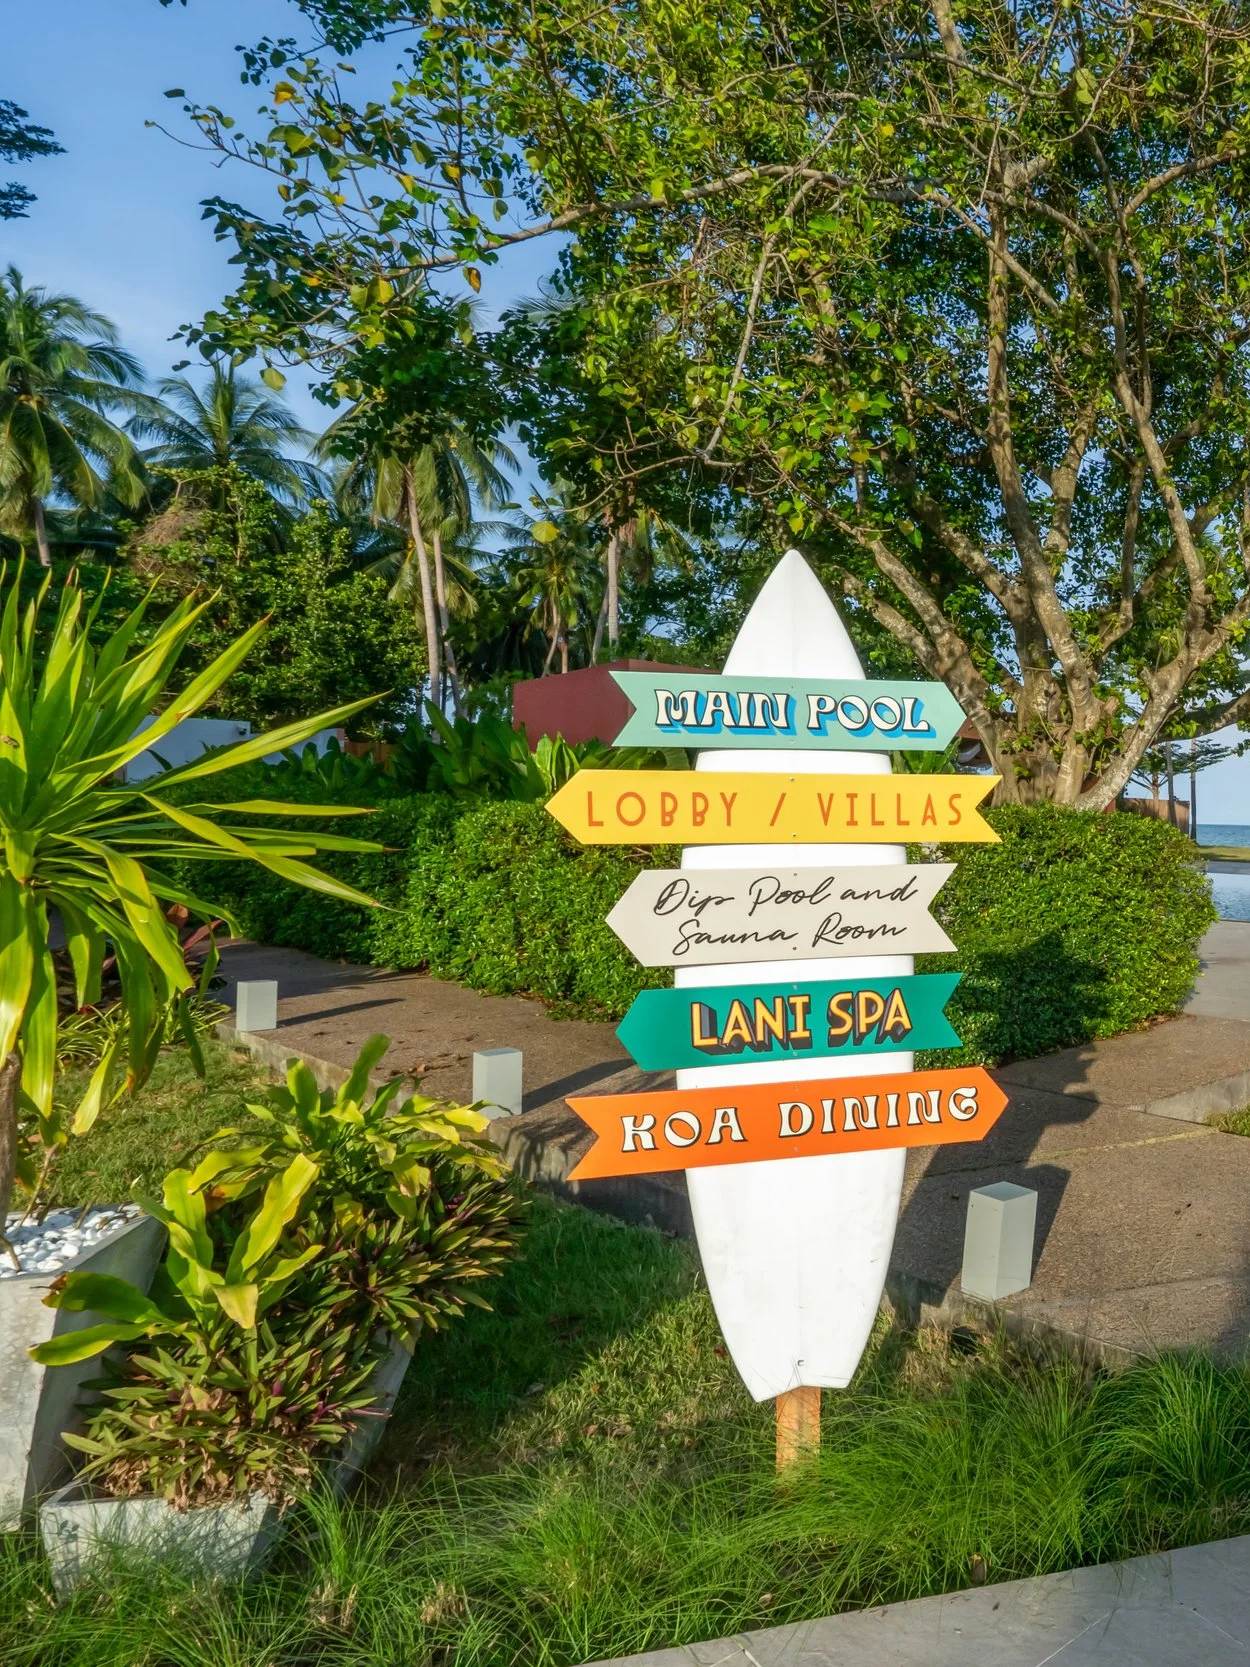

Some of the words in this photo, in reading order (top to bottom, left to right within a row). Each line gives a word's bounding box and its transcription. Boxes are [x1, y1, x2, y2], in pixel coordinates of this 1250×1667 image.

[654, 688, 797, 736] MAIN
[807, 693, 937, 740] POOL
[587, 790, 738, 827] LOBBY
[769, 792, 787, 827] /
[816, 792, 962, 827] VILLAS
[653, 878, 735, 917] Dip
[749, 876, 835, 917] Pool
[840, 875, 919, 902] and
[672, 919, 799, 956] Sauna
[812, 912, 907, 948] Room
[689, 995, 812, 1055] LANI
[827, 988, 913, 1047] SPA
[620, 1107, 748, 1153] KOA
[778, 1086, 979, 1138] DINING
